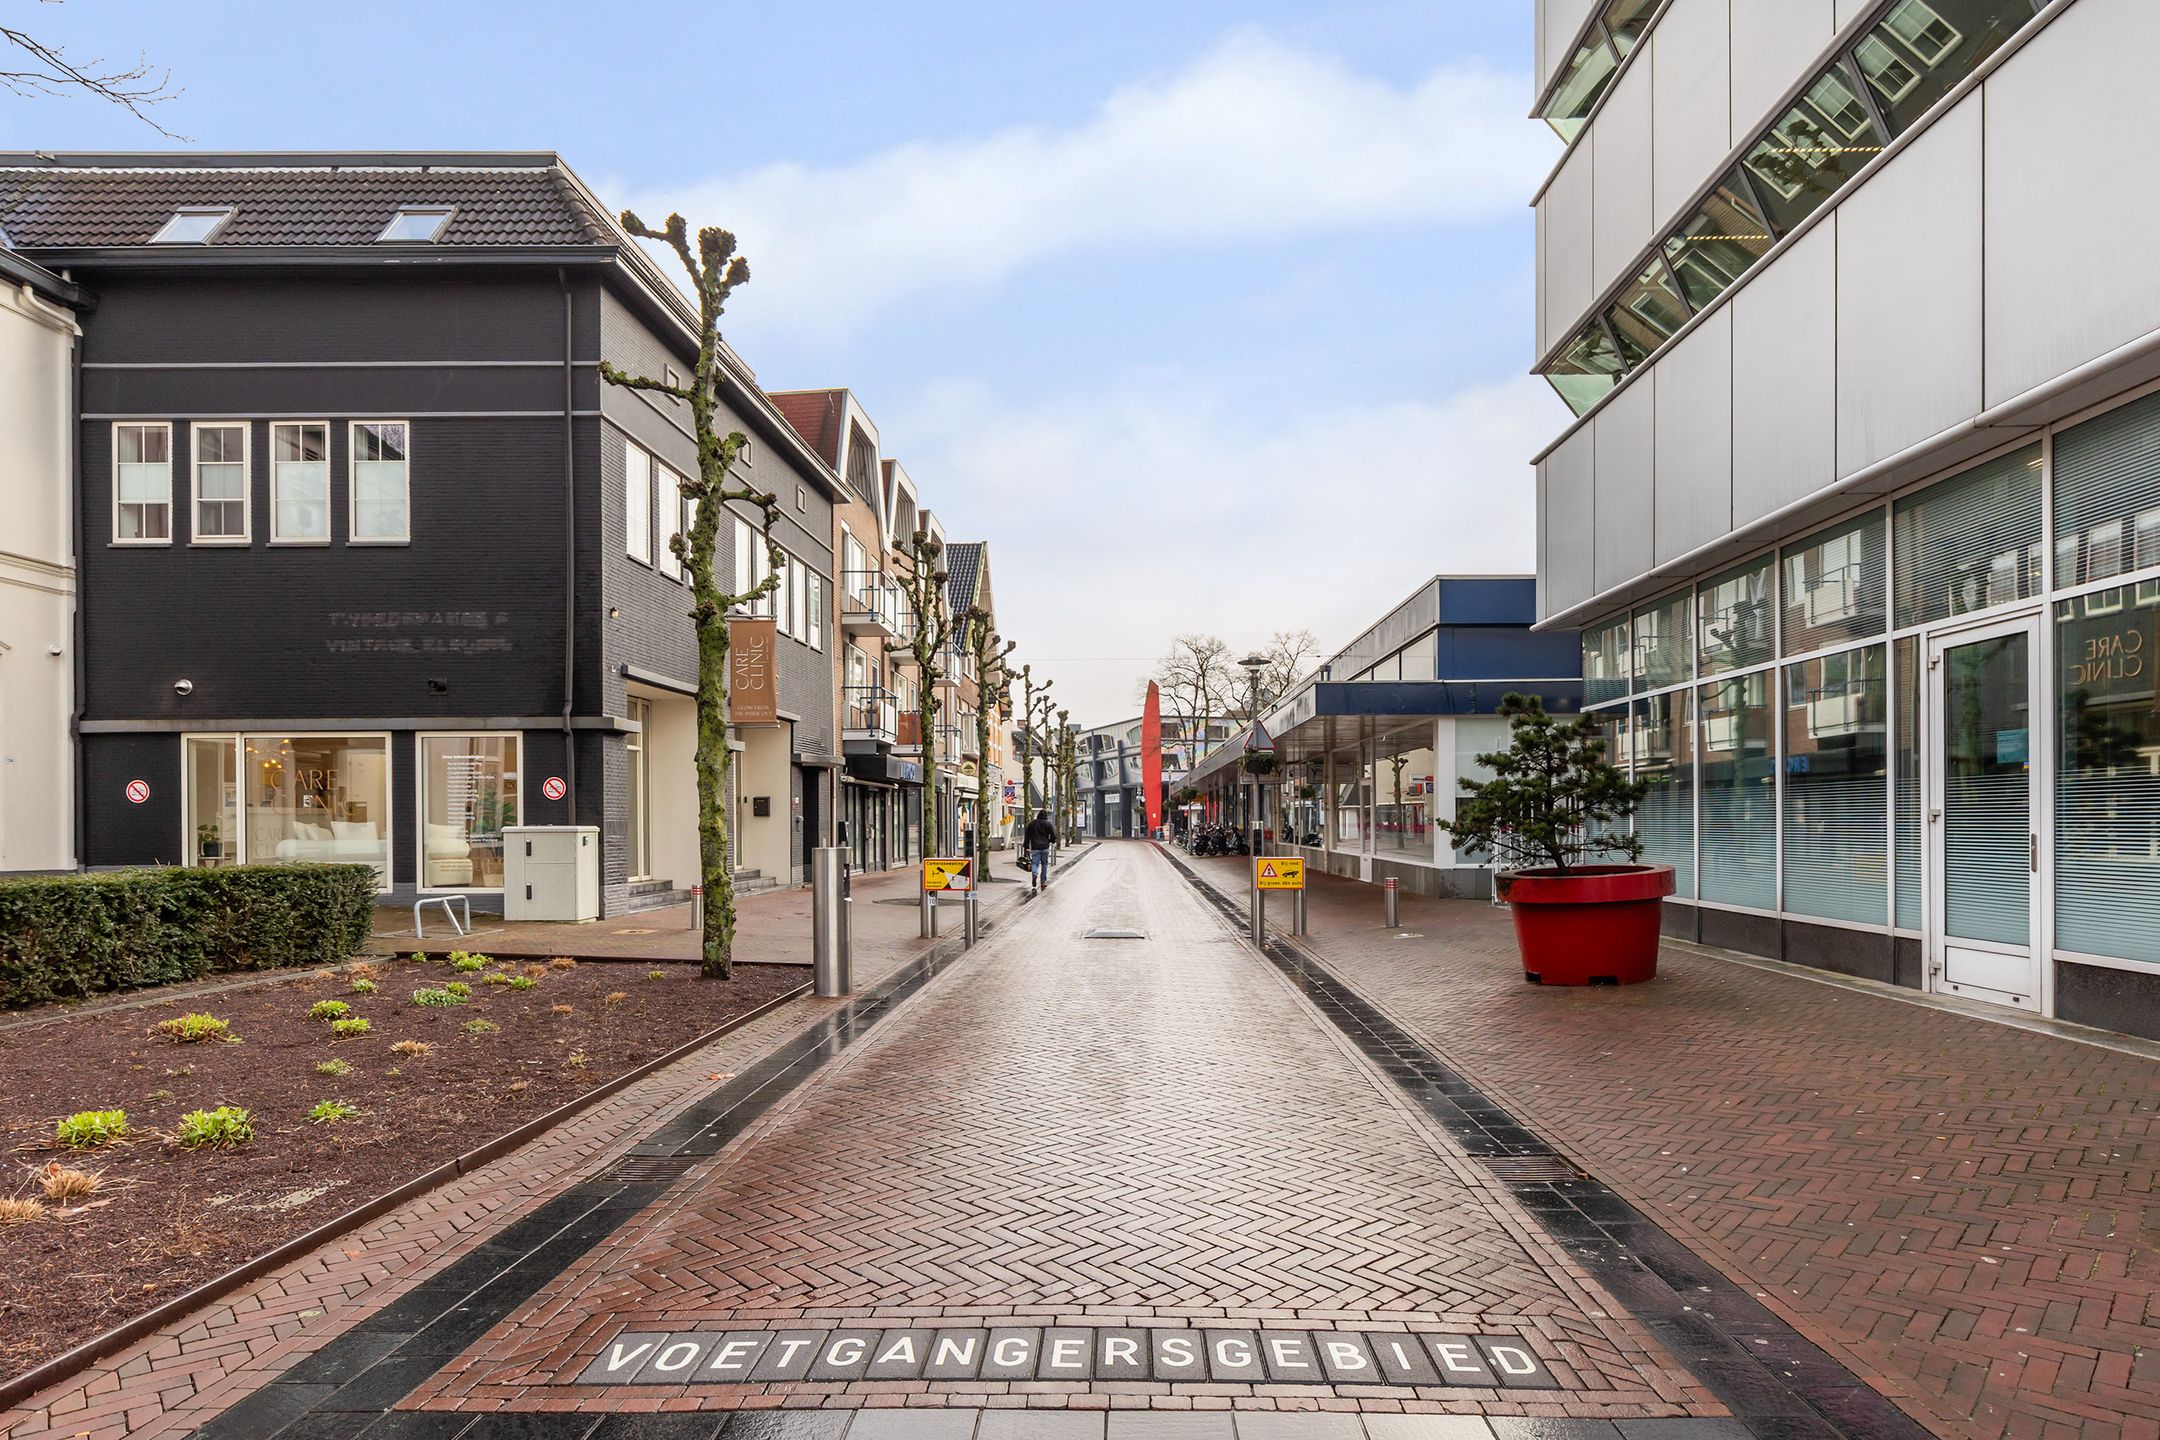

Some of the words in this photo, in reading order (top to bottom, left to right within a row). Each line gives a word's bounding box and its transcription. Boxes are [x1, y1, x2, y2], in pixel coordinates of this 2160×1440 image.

[735, 647, 749, 690] CARE
[750, 636, 764, 690] CLINIC
[270, 769, 340, 792] CARE
[270, 793, 357, 816] CLINIC
[607, 1337, 1537, 1374] VOETGANGERSGEBIED
